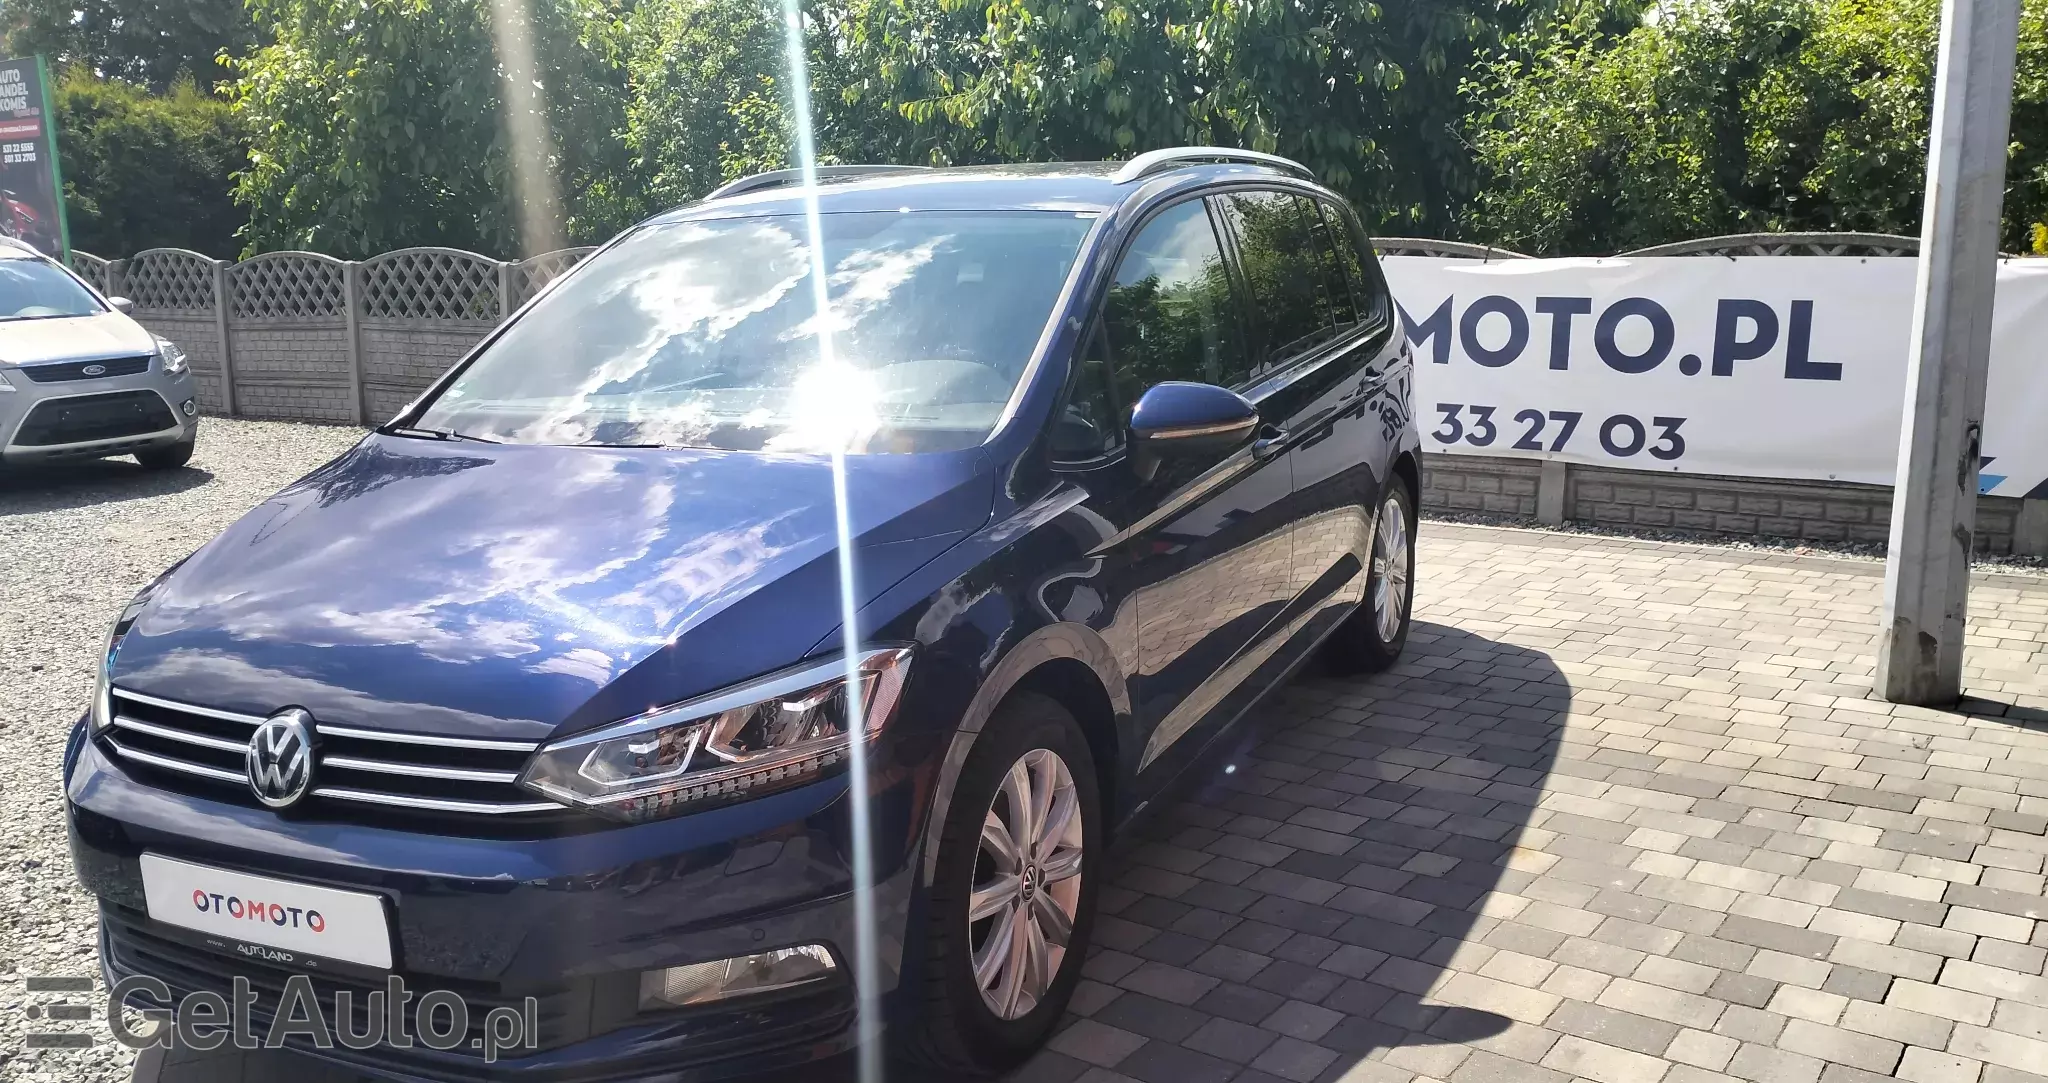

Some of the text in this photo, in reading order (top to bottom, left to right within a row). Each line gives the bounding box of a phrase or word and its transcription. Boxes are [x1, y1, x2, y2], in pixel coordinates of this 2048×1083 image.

[1393, 293, 1842, 382] MOTO.PL
[1431, 402, 1498, 448] 33
[1511, 408, 1584, 453] 27
[192, 889, 325, 933] OTOMOTO
